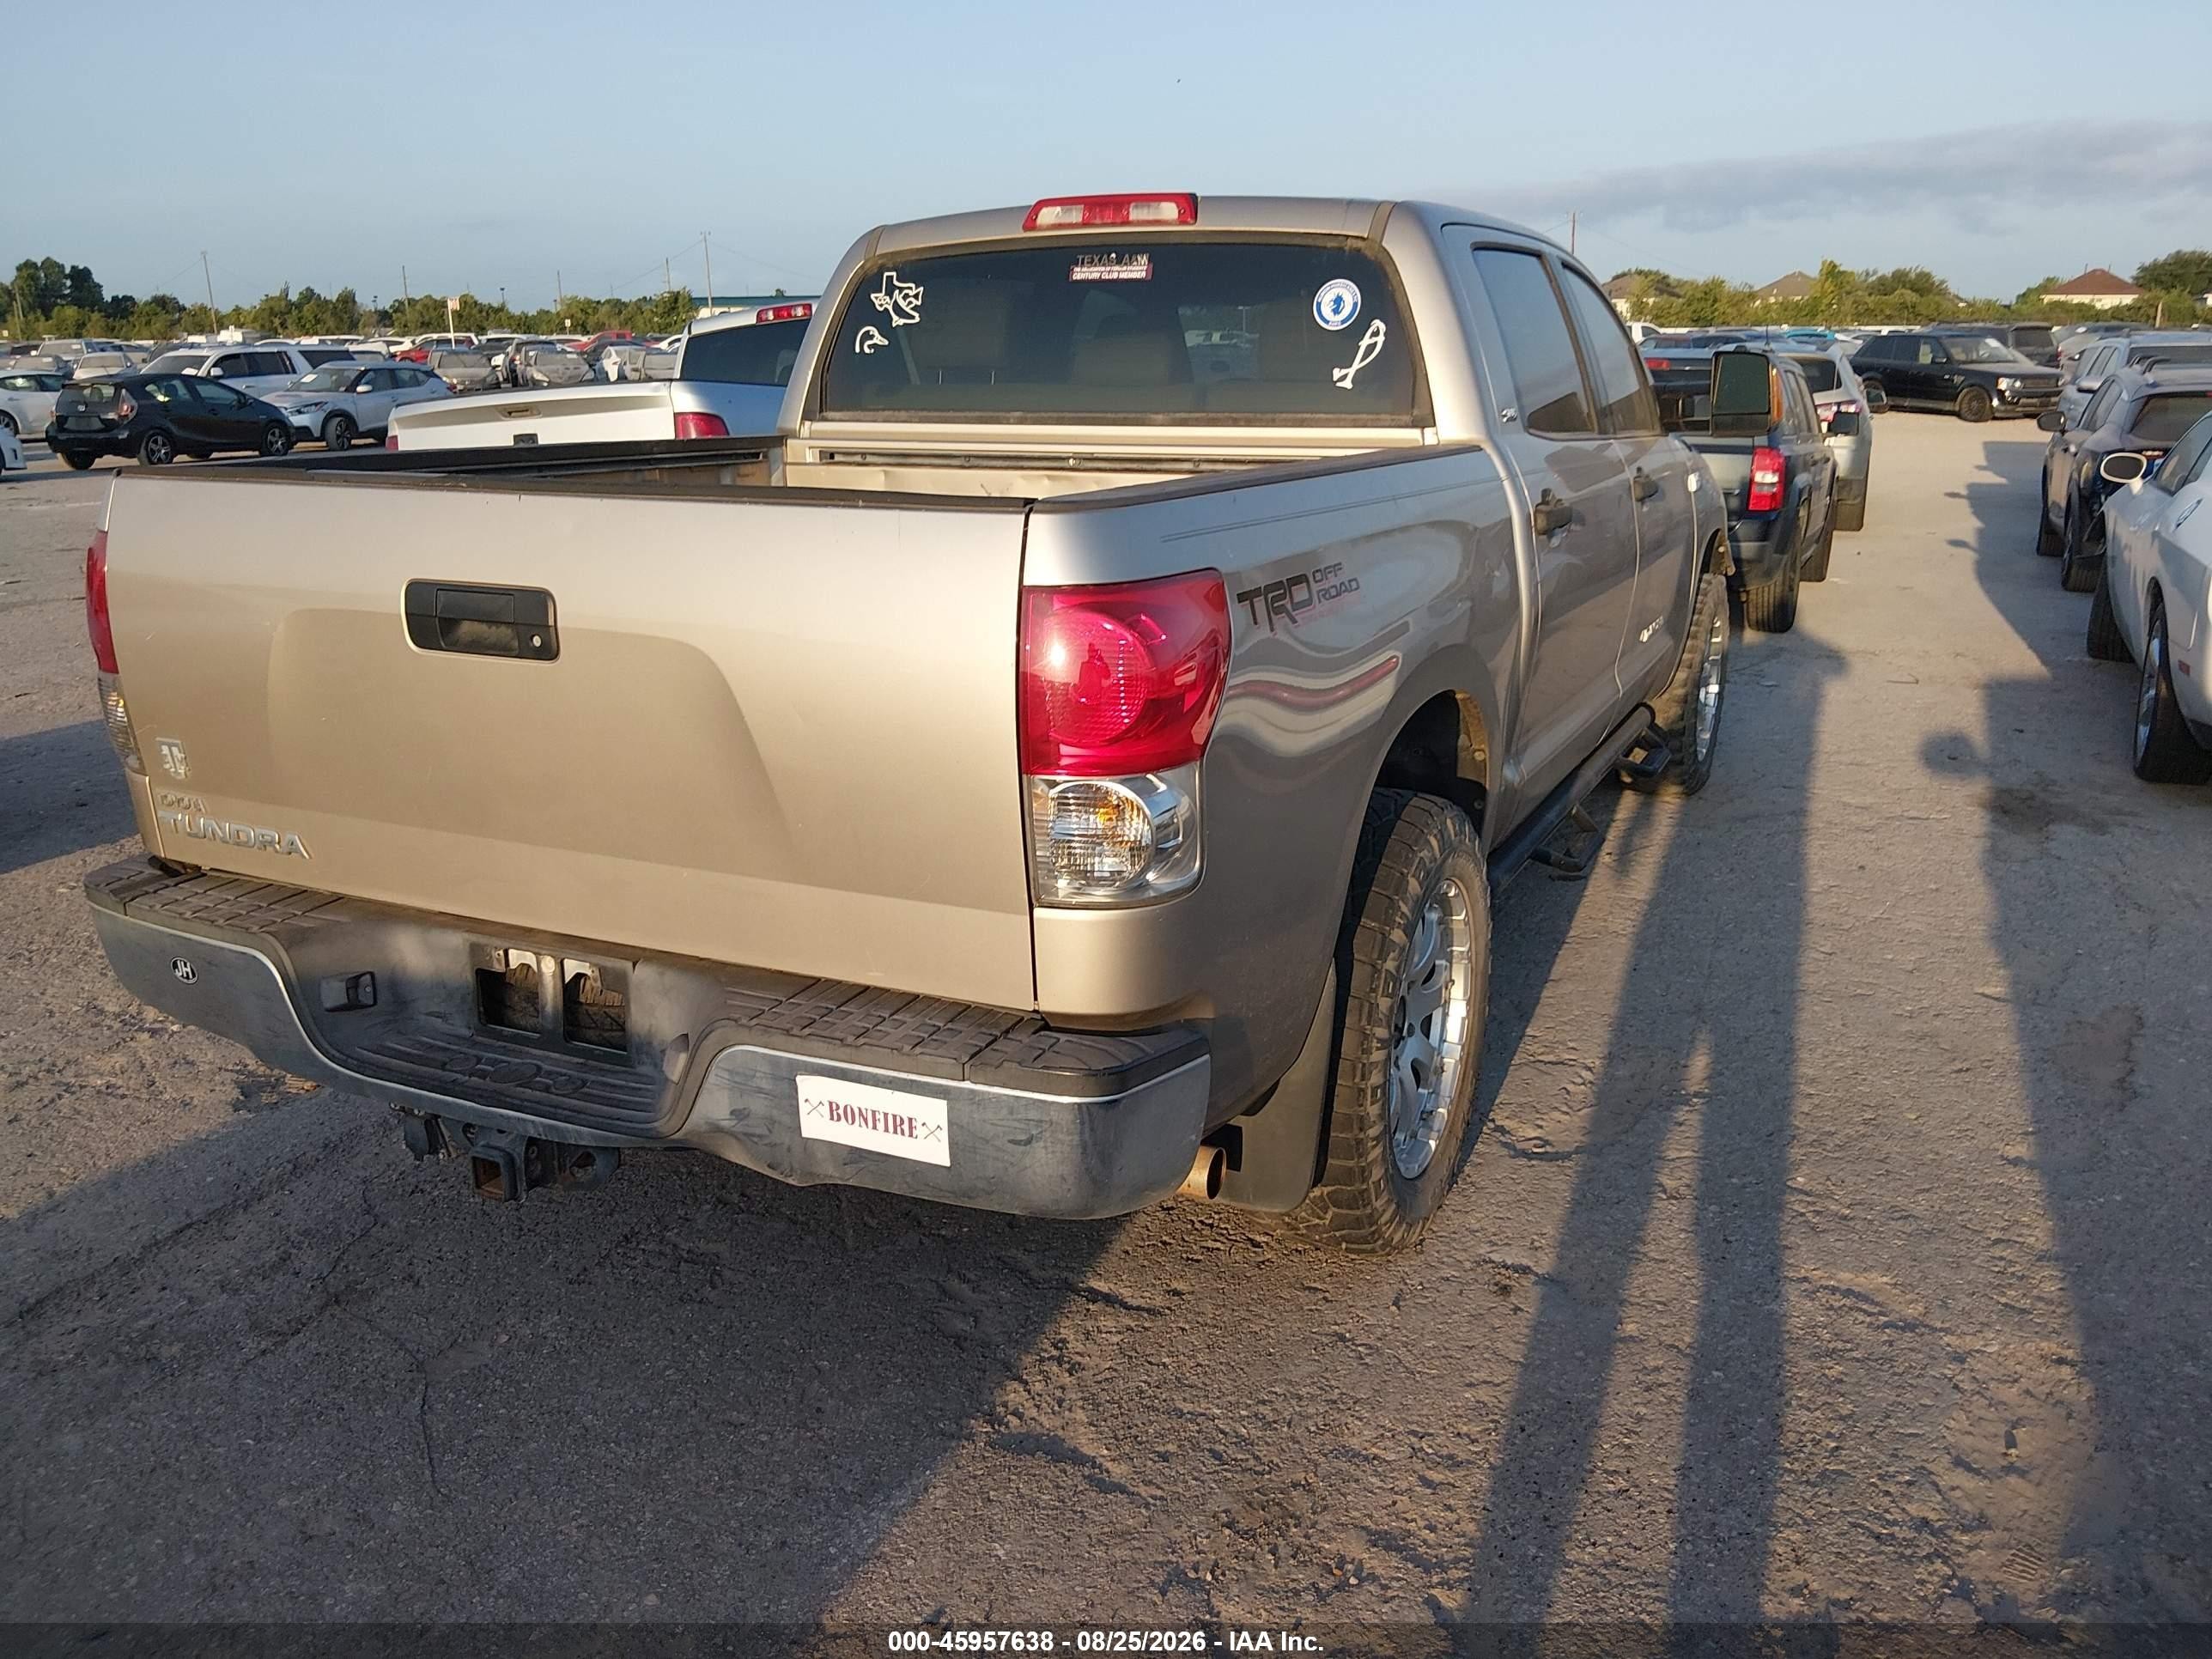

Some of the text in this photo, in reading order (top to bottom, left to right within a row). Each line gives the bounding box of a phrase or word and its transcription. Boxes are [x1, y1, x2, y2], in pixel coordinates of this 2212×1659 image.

[1077, 254, 1117, 267] TEXAS
[1073, 270, 1146, 281] CENTURY CLUB MEMBER
[1312, 562, 1344, 584] OFF
[1237, 574, 1314, 633] TRD
[1316, 577, 1361, 605] ROAD
[157, 810, 311, 860] TUNDRA
[174, 959, 193, 978] JH
[828, 1099, 919, 1139] BONFIRE
